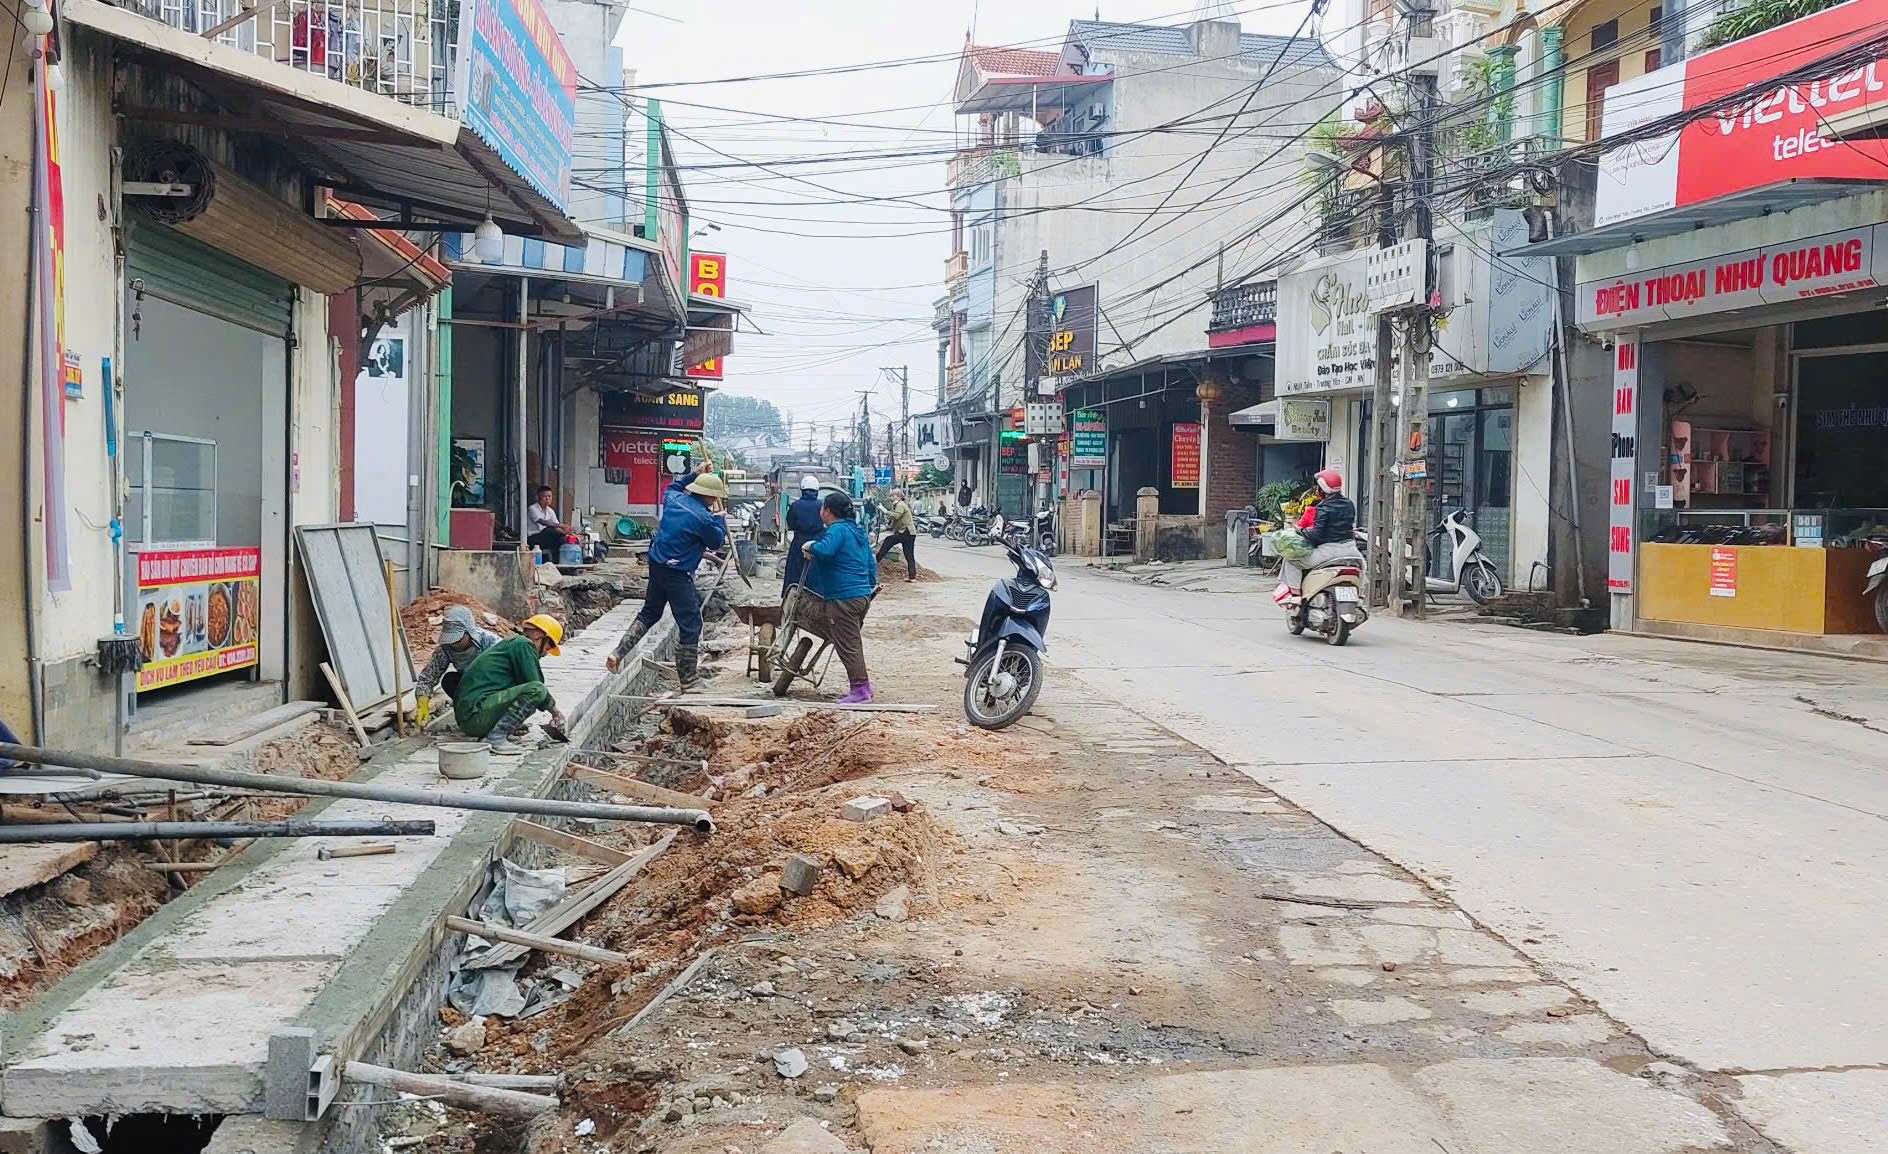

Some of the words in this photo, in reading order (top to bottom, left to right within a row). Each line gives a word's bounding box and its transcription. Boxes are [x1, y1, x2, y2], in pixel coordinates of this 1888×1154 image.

[1718, 62, 1884, 135] viettel
[1595, 281, 1640, 318] ĐIỆN
[1645, 268, 1706, 306] THOẠI
[1715, 253, 1768, 295] NHƯ
[1772, 239, 1862, 287] QUANG
[1344, 361, 1358, 374] Học
[1618, 343, 1635, 370] MUA
[668, 391, 699, 407] SANG
[1616, 381, 1633, 415] BÁN
[611, 440, 658, 454] viette
[1611, 432, 1635, 459] iPhone
[1613, 479, 1631, 505] SAM
[1611, 526, 1631, 553] SUNG
